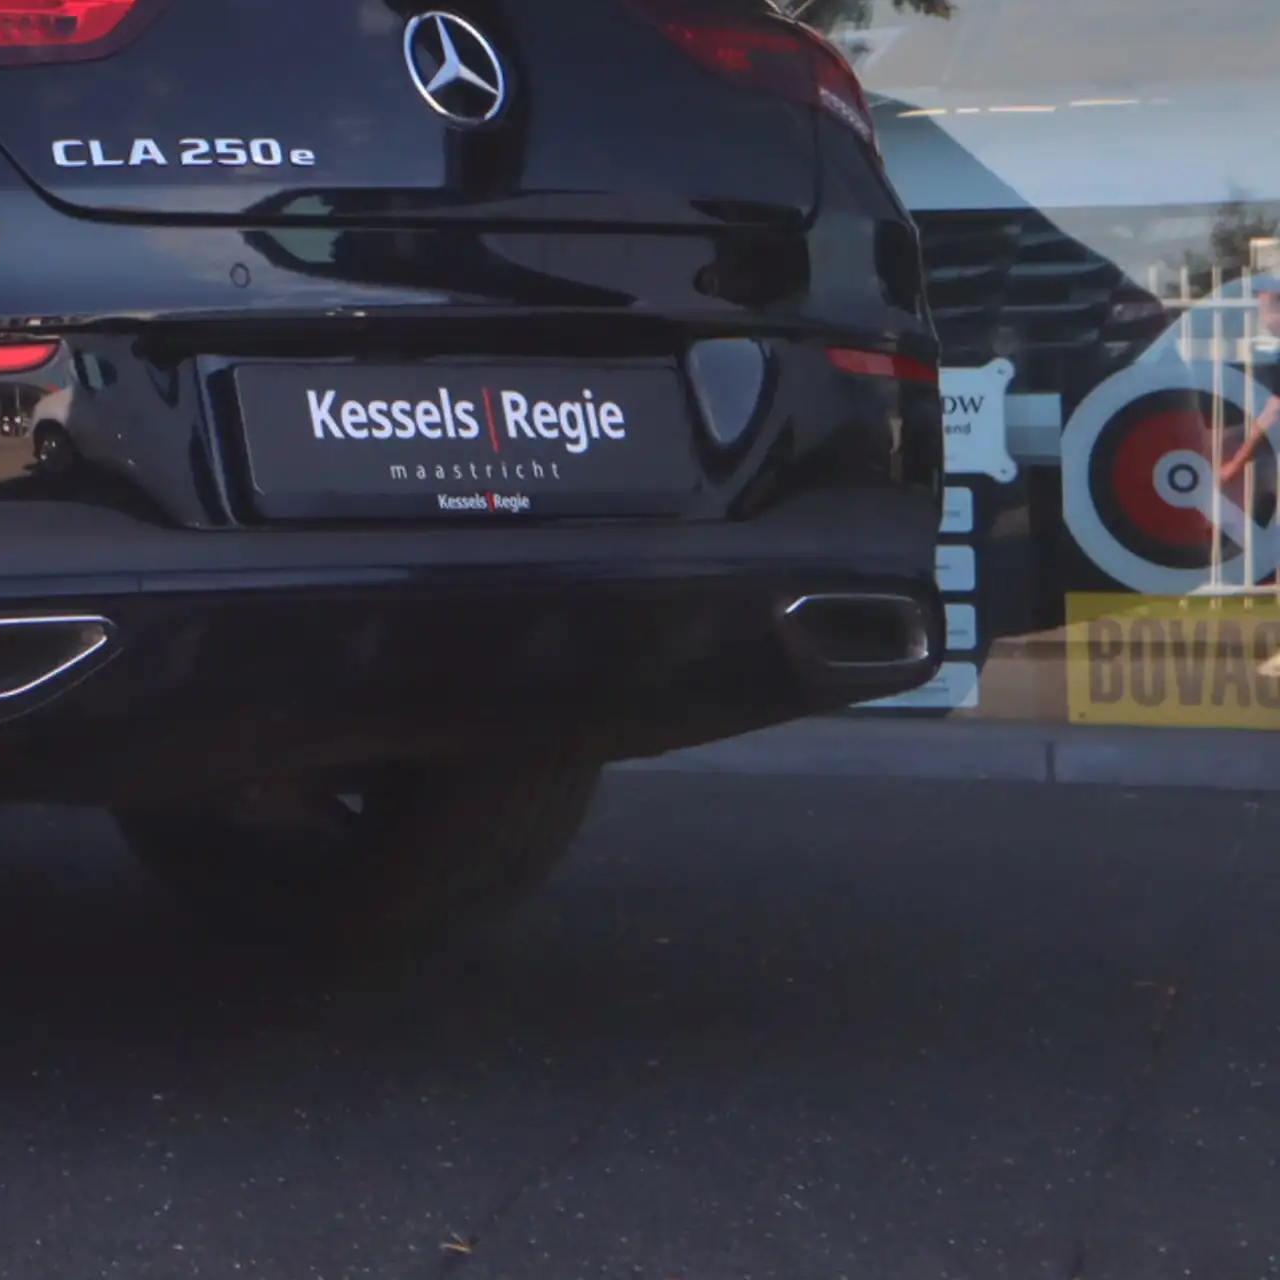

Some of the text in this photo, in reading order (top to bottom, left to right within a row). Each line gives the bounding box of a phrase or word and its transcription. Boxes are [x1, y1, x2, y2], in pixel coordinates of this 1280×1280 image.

[52, 138, 169, 167] CLA
[942, 396, 985, 415] DW
[306, 387, 626, 453] Kessels Regie
[390, 461, 560, 480] maastricht
[437, 493, 530, 512] Kessels Regie
